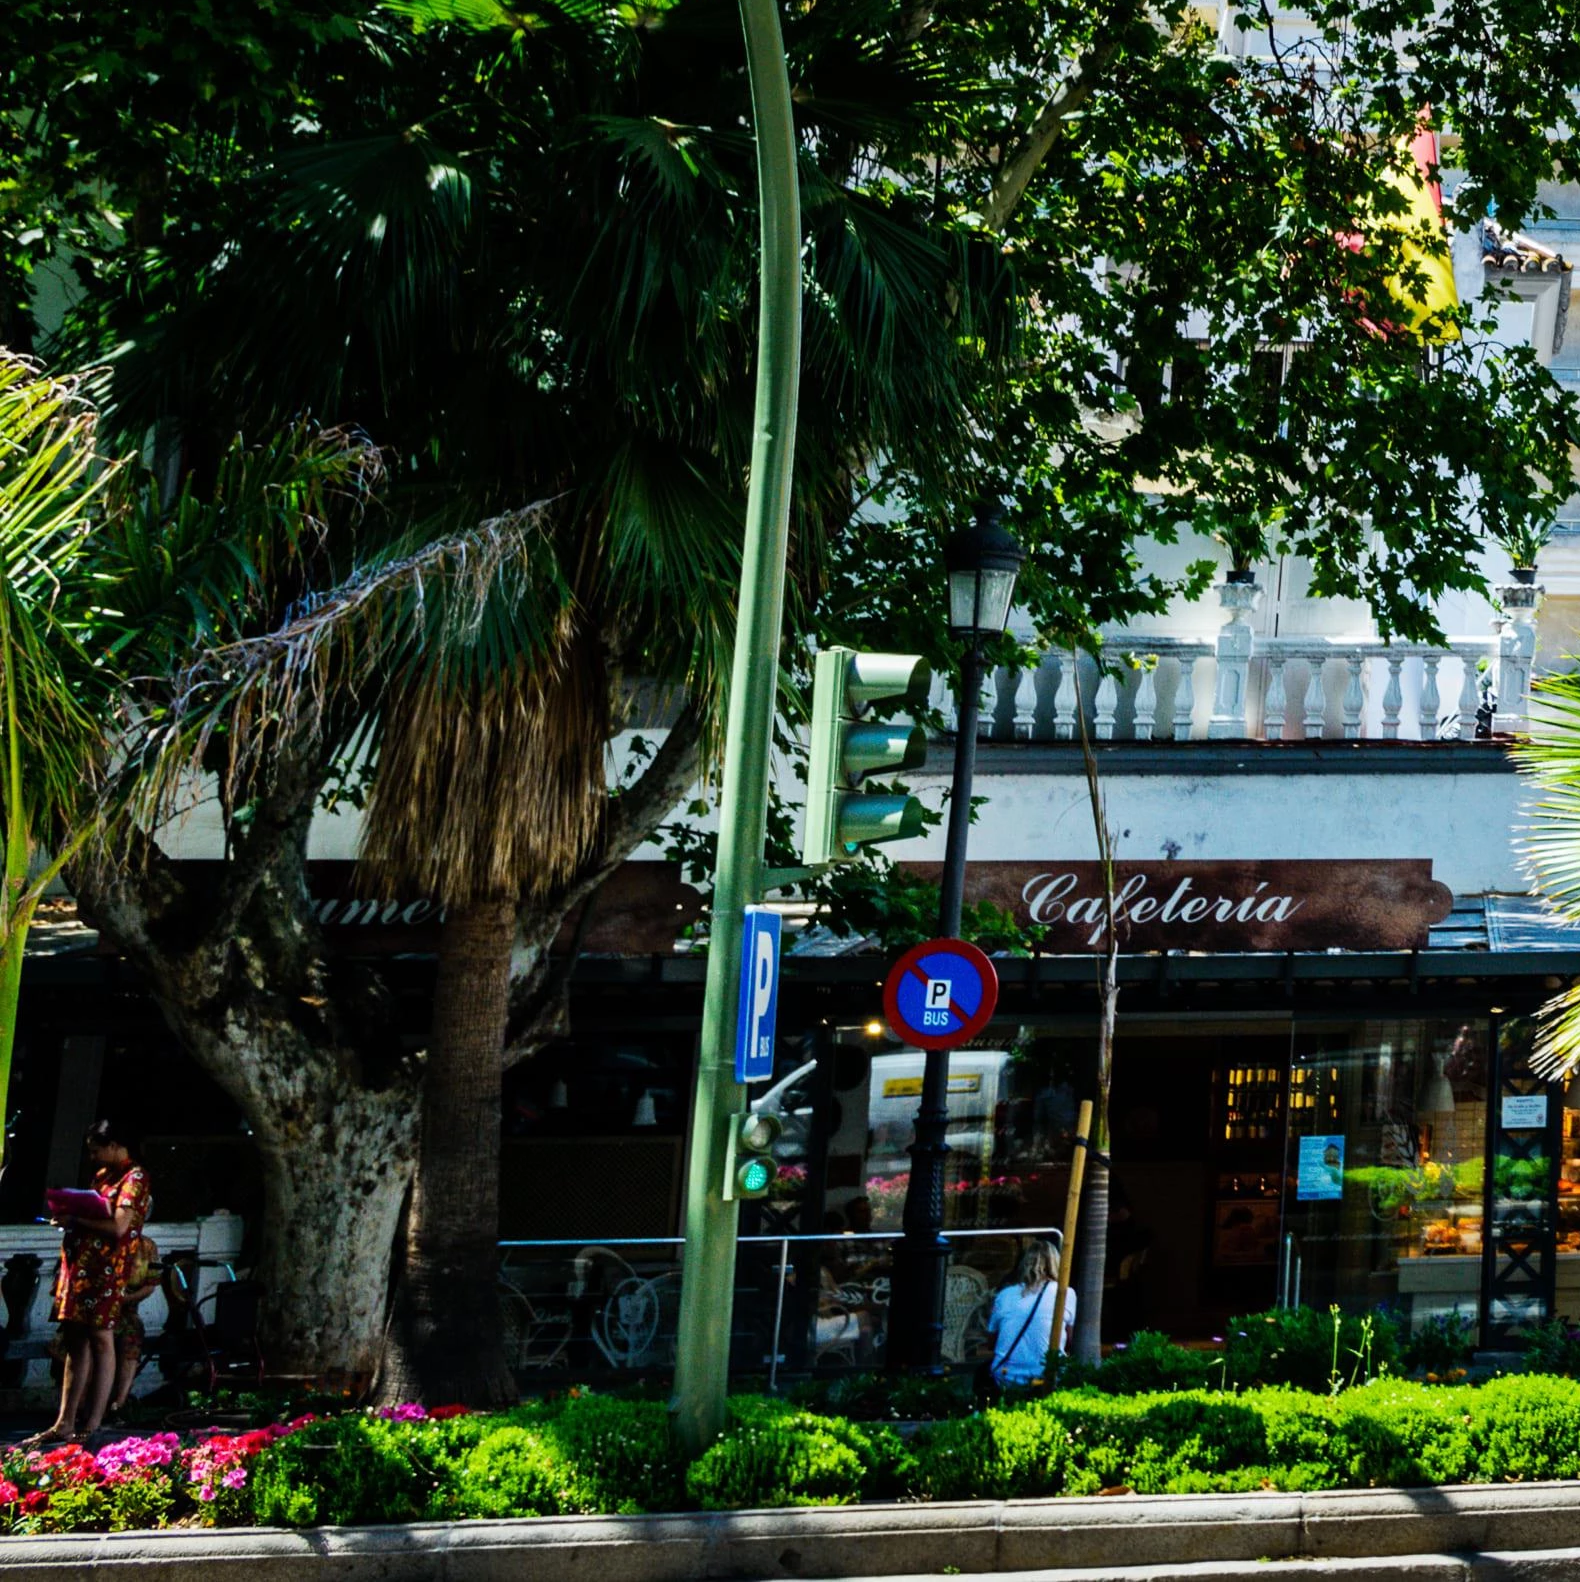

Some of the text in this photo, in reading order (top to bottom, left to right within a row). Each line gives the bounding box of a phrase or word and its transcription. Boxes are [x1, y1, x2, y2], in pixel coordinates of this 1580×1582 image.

[1022, 873, 1306, 946] Cafetería
[750, 931, 774, 1059] P
[931, 982, 947, 1005] P
[922, 1011, 949, 1026] BUS
